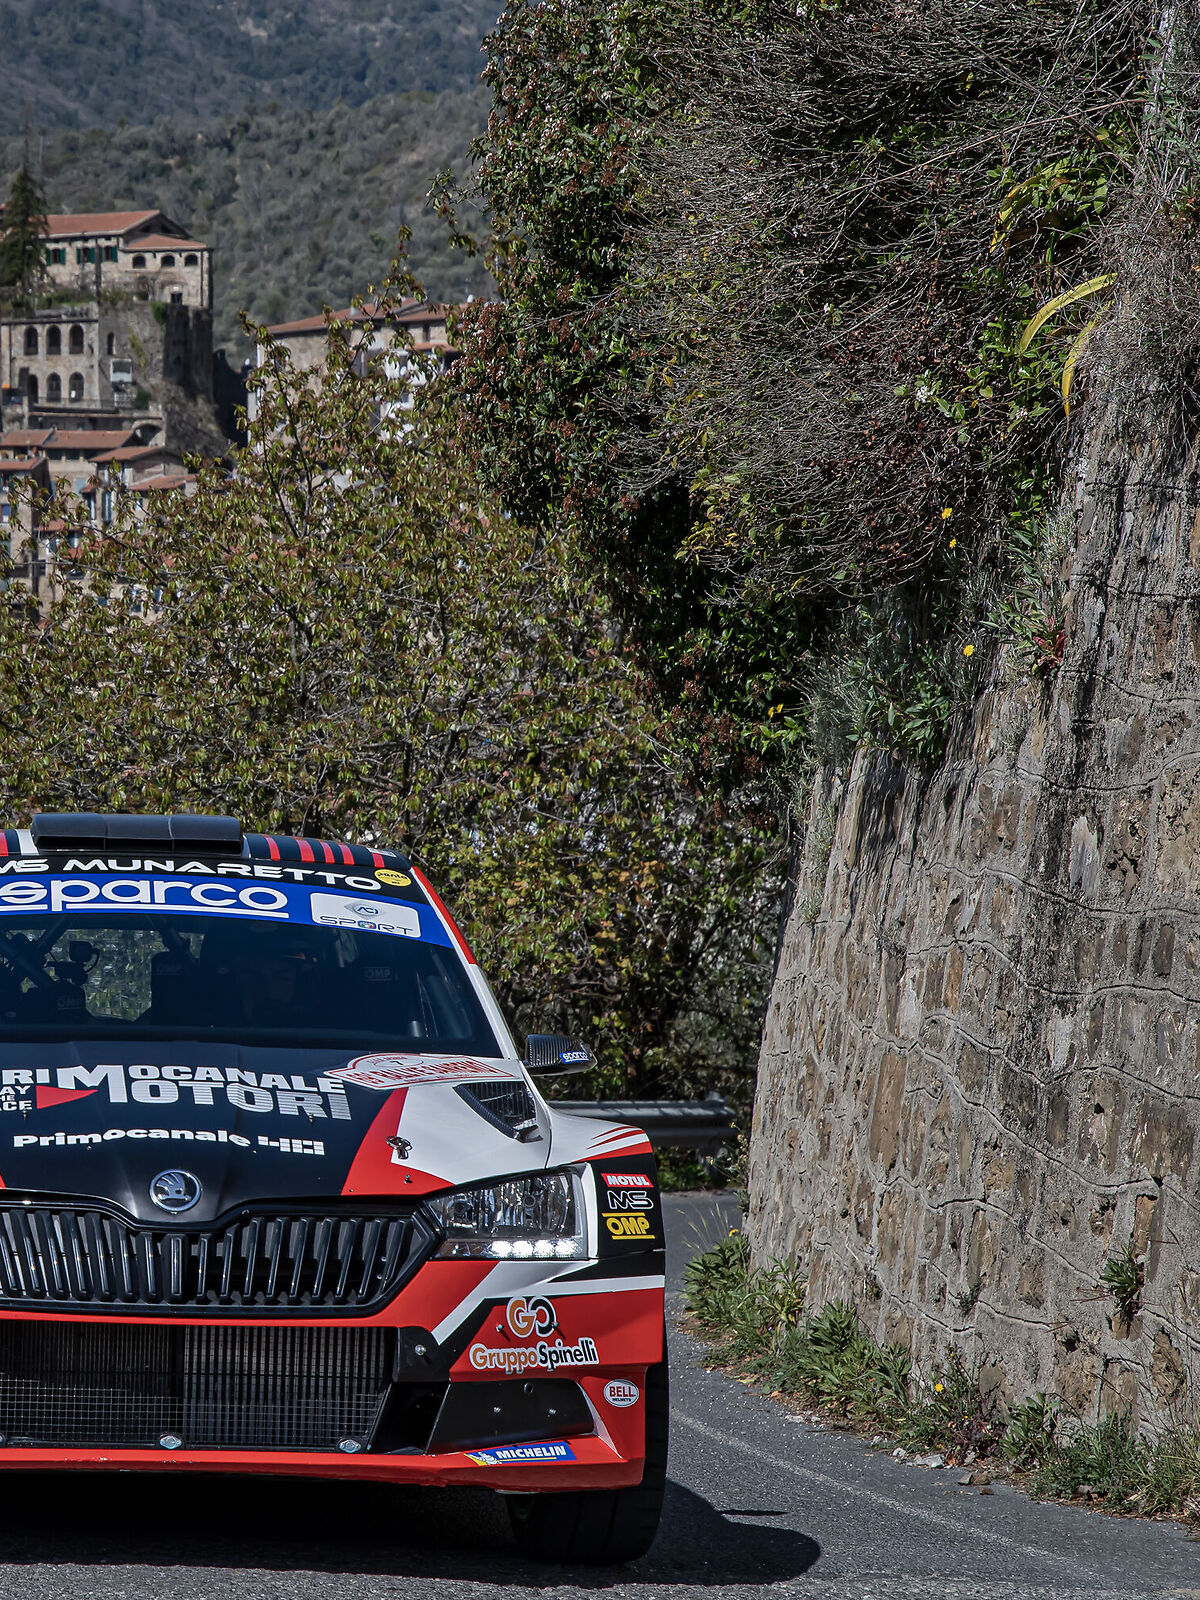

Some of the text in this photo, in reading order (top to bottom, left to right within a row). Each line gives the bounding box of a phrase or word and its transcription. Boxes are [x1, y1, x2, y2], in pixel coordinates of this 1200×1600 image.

[63, 859, 382, 890] MUNARETTO
[319, 915, 414, 936] SPORT
[13, 1128, 251, 1148] Primocanale
[605, 1175, 651, 1187] MOTUL
[605, 1216, 651, 1236] OMP
[609, 1386, 635, 1397] BELL
[495, 1445, 567, 1459] MICHELIN
